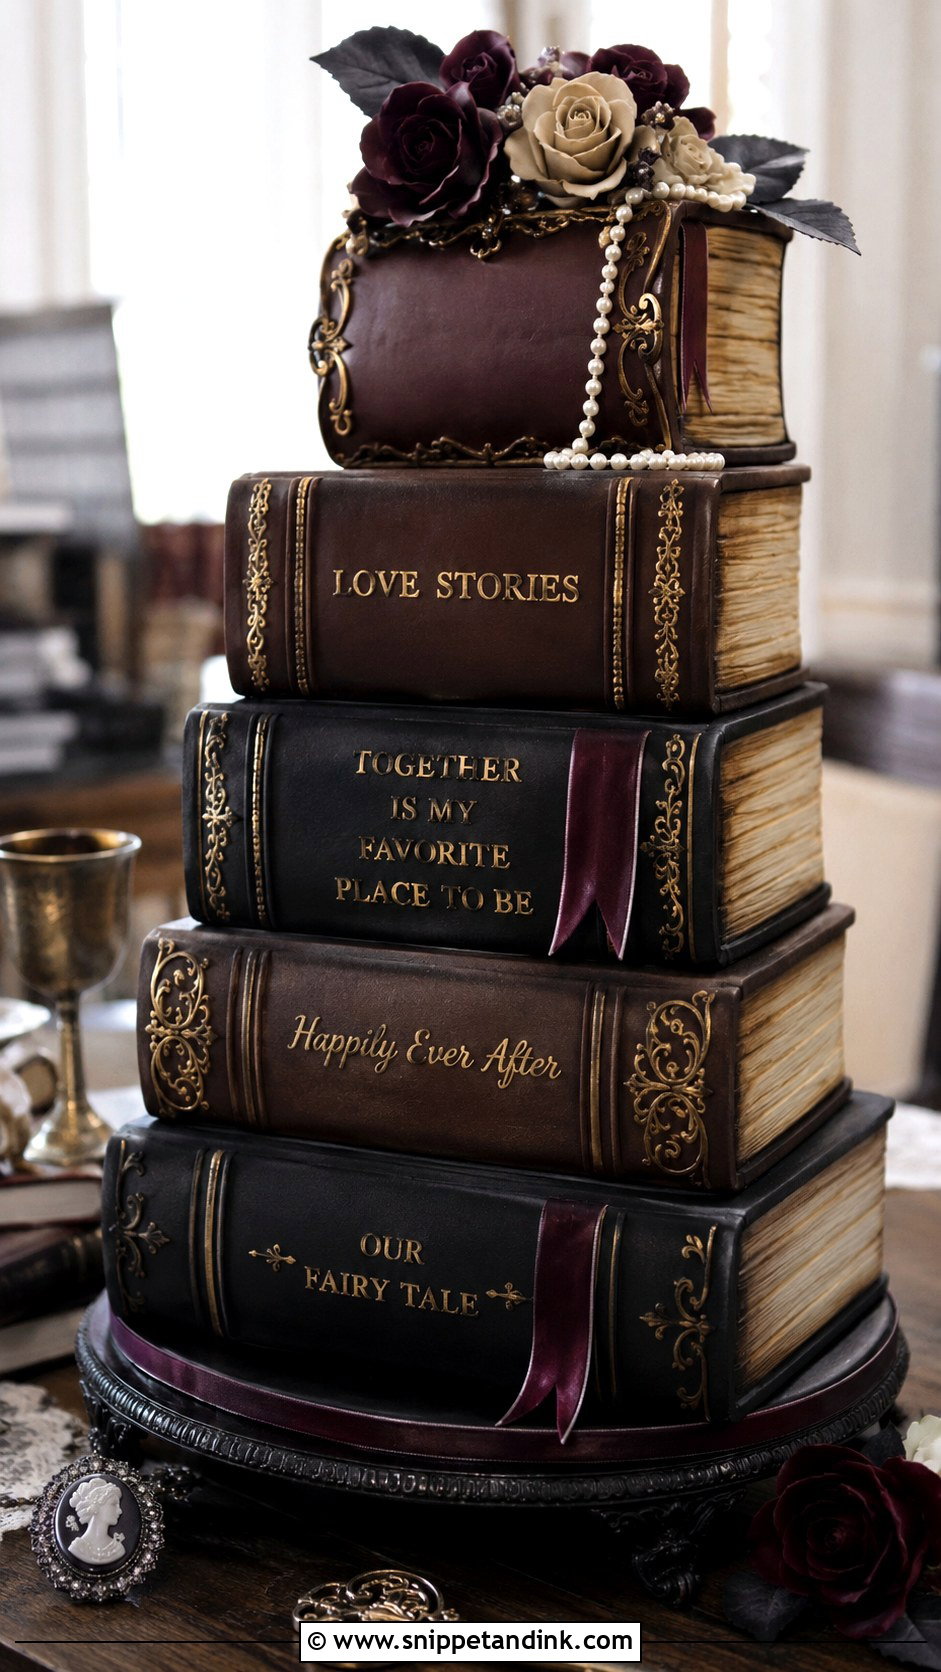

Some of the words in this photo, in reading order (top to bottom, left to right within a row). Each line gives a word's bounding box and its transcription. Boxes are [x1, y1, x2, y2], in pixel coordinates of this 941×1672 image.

[333, 569, 420, 599] LOVE
[436, 571, 580, 602] STORIES
[353, 749, 522, 783] TOGETHER
[391, 795, 416, 821] IS
[428, 797, 478, 825] MY
[359, 836, 511, 870] FAVORITE
[335, 877, 430, 908] PLACE
[441, 884, 484, 912] TO
[494, 889, 534, 915] BE
[287, 1014, 398, 1074] Happily
[406, 1028, 475, 1070] Ever
[481, 1037, 562, 1090] After
[360, 1232, 425, 1265] OUR
[304, 1265, 391, 1302] FAIRY
[400, 1282, 479, 1317] TALE
